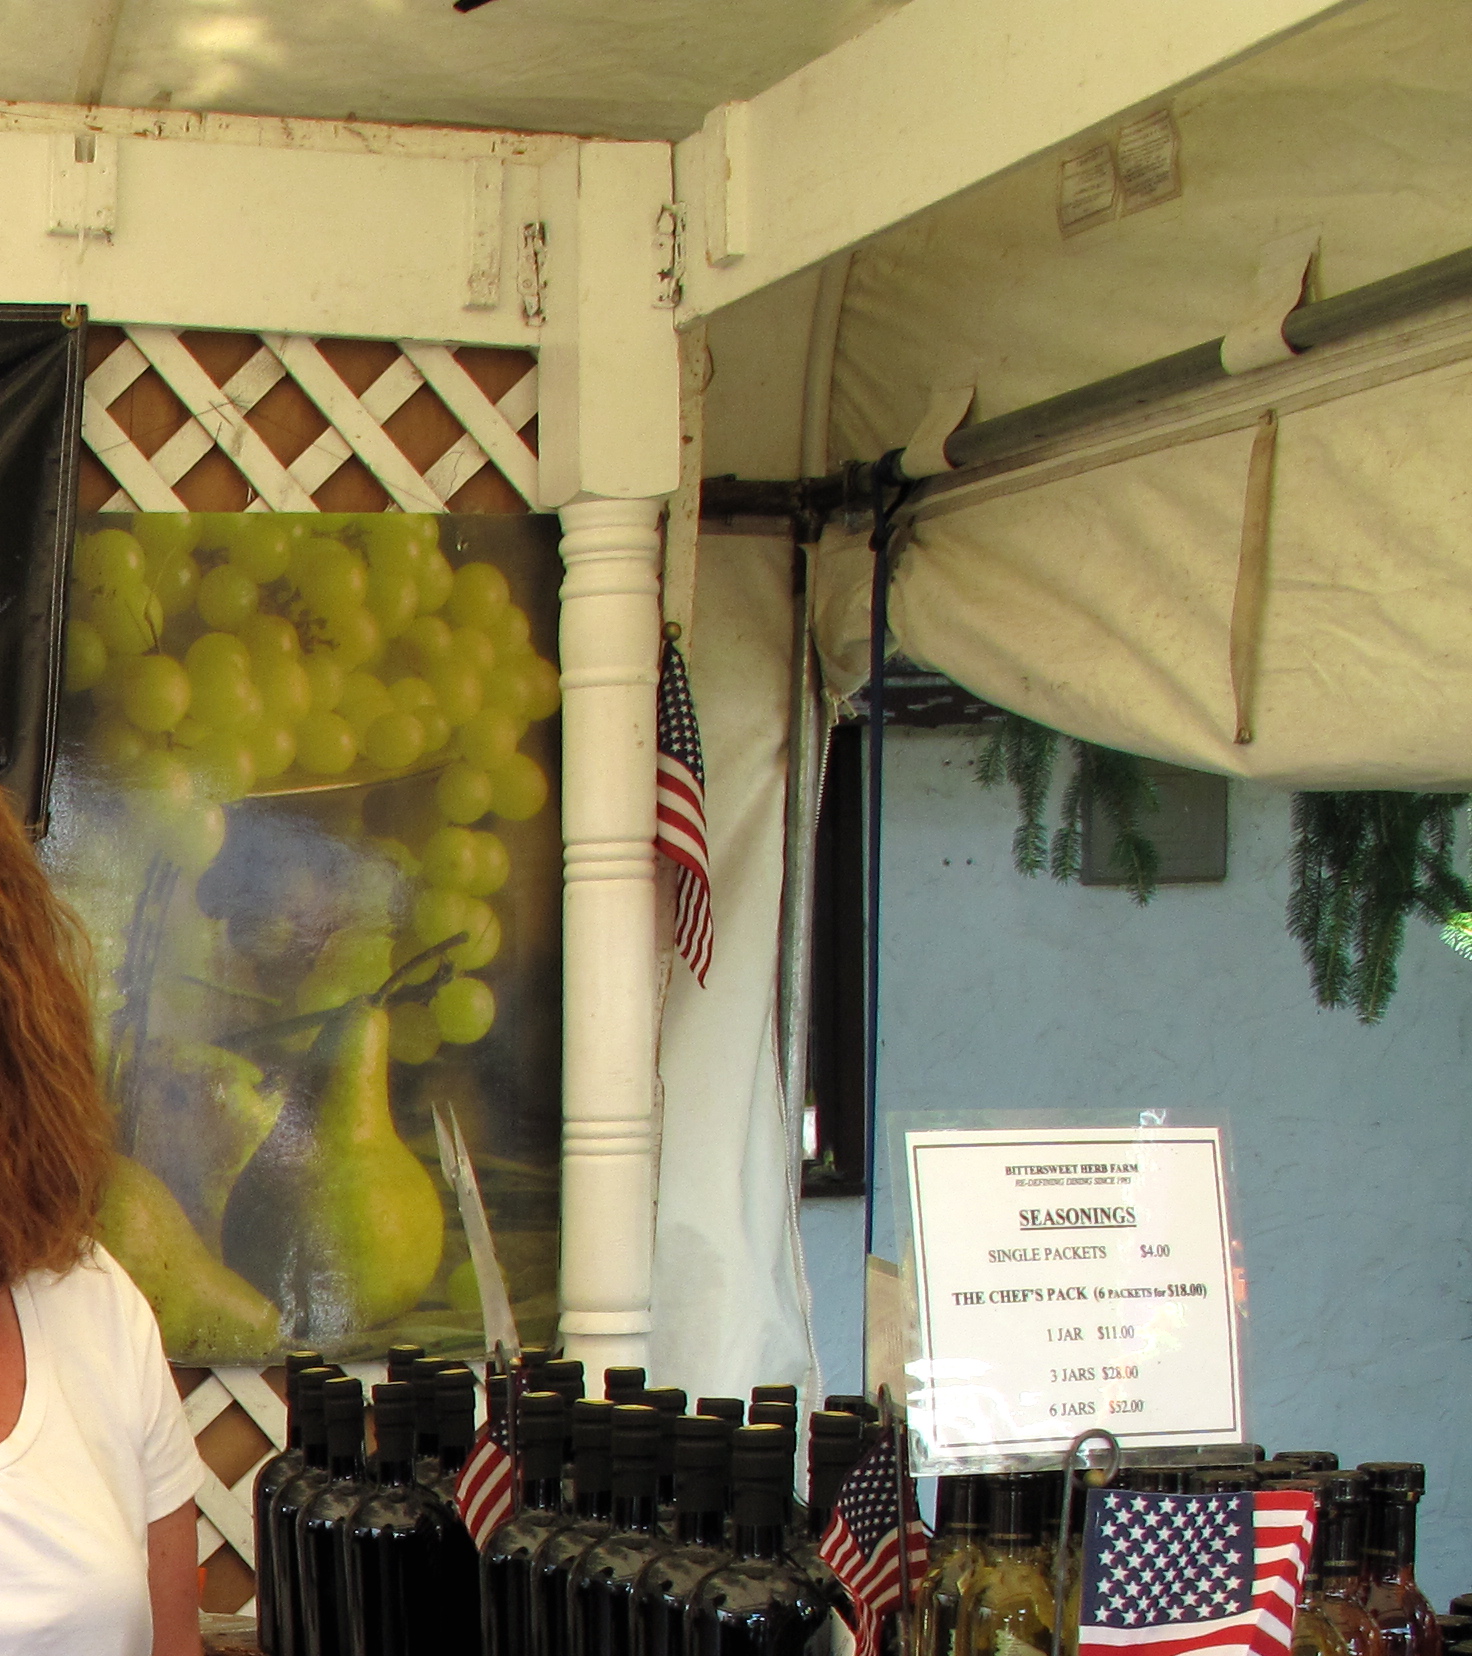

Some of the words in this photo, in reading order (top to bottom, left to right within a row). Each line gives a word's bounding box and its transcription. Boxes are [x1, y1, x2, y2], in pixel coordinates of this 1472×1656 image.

[1006, 1165, 1078, 1176] BITTERSWEET
[1081, 1164, 1108, 1174] HERB
[1110, 1163, 1138, 1173] FARM
[1019, 1207, 1136, 1227] SEASONINGS
[988, 1249, 1041, 1263] SINGLE
[1044, 1246, 1107, 1261] PACKETS
[1140, 1244, 1170, 1258] $4.00
[952, 1291, 985, 1305] THE
[989, 1289, 1043, 1304] CHEF'S
[1047, 1287, 1088, 1301] PACK
[1094, 1287, 1105, 1302] (6
[1108, 1288, 1153, 1299] PACKETS
[1154, 1287, 1166, 1298] for
[1168, 1283, 1206, 1299] $18.00)
[1047, 1328, 1053, 1342] 1
[1057, 1328, 1083, 1341] JAR
[1097, 1326, 1135, 1340] $11.00
[1050, 1369, 1057, 1382] 3
[1062, 1367, 1095, 1381] JARS
[1102, 1365, 1138, 1380] $28.00
[1049, 1403, 1057, 1416] 6
[1061, 1402, 1095, 1415] JARS
[1109, 1400, 1144, 1414] $52.00
